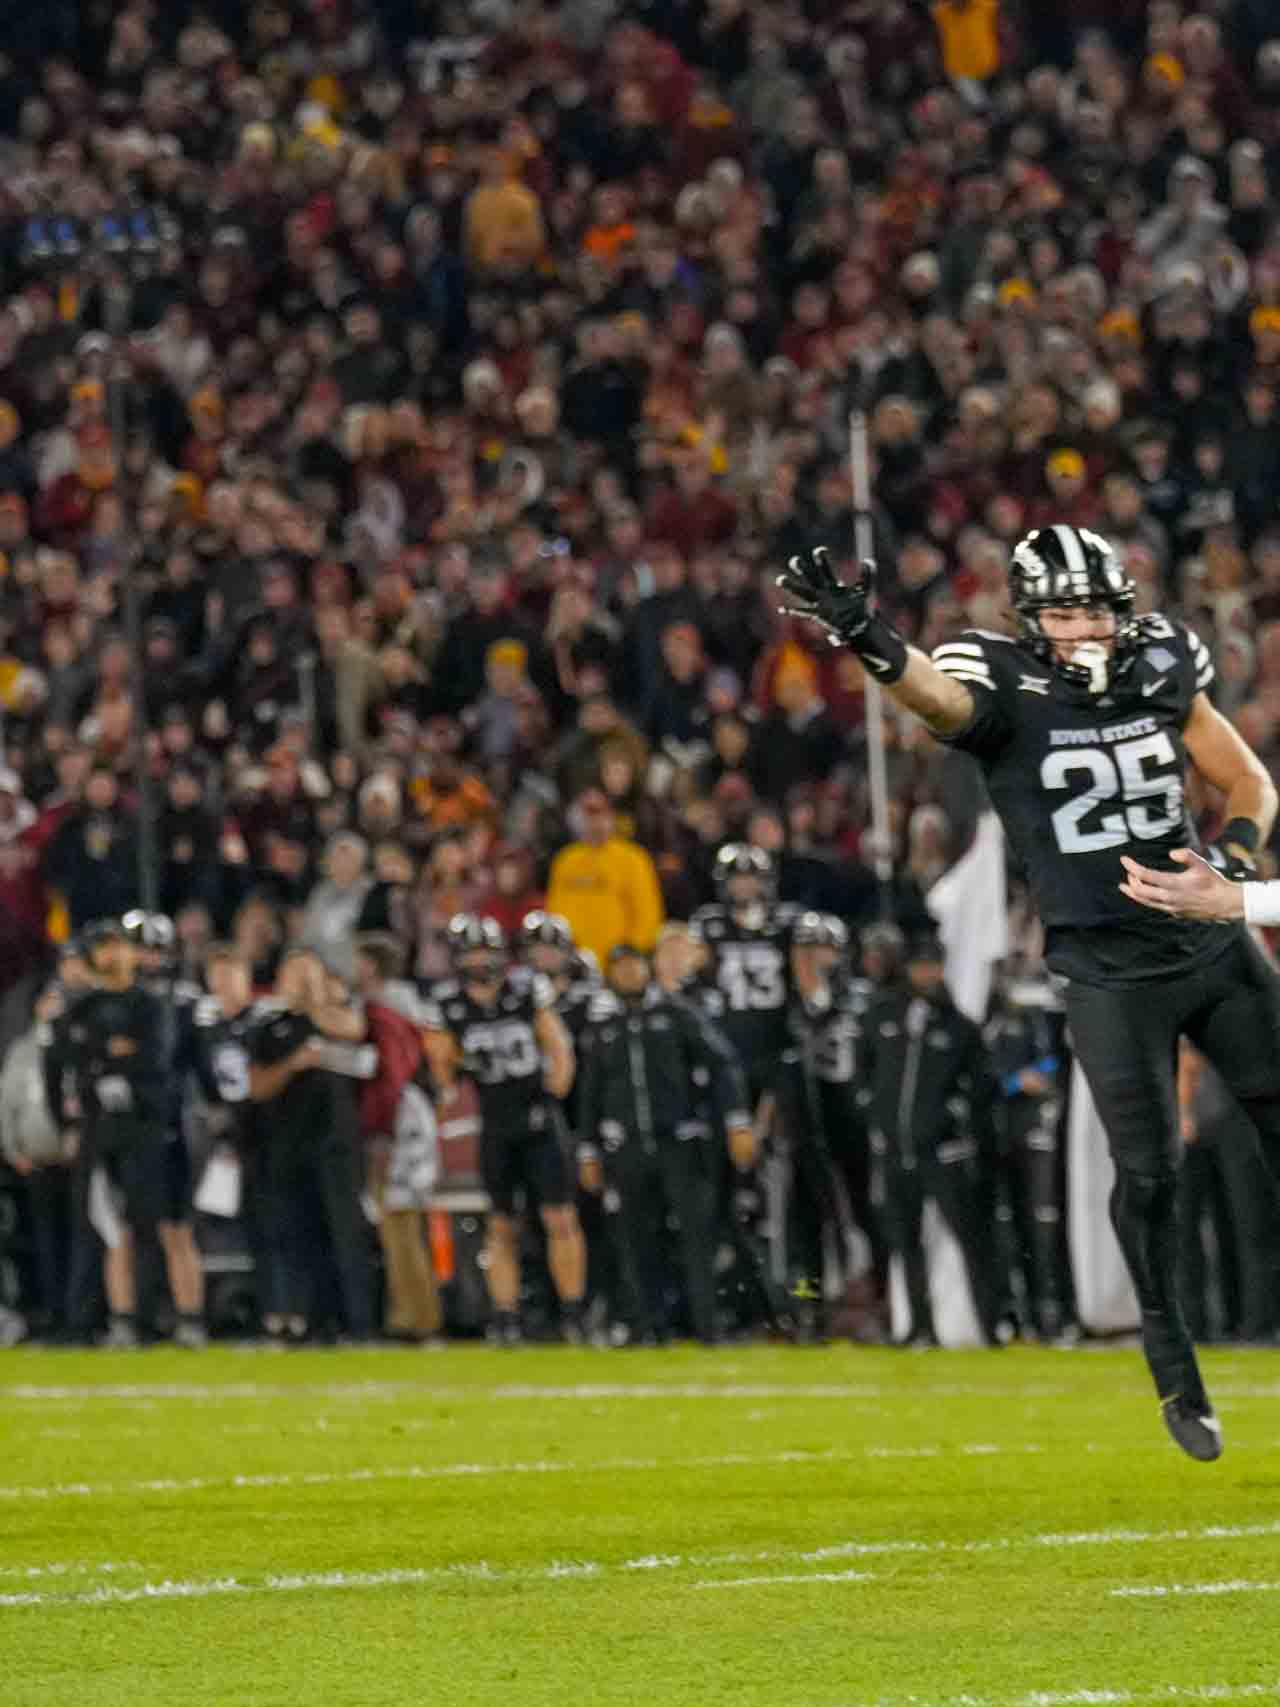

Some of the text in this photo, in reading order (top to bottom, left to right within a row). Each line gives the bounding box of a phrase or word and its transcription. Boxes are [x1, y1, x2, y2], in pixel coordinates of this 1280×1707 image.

[1050, 717, 1158, 745] IOWA STATE
[1040, 731, 1183, 854] 25
